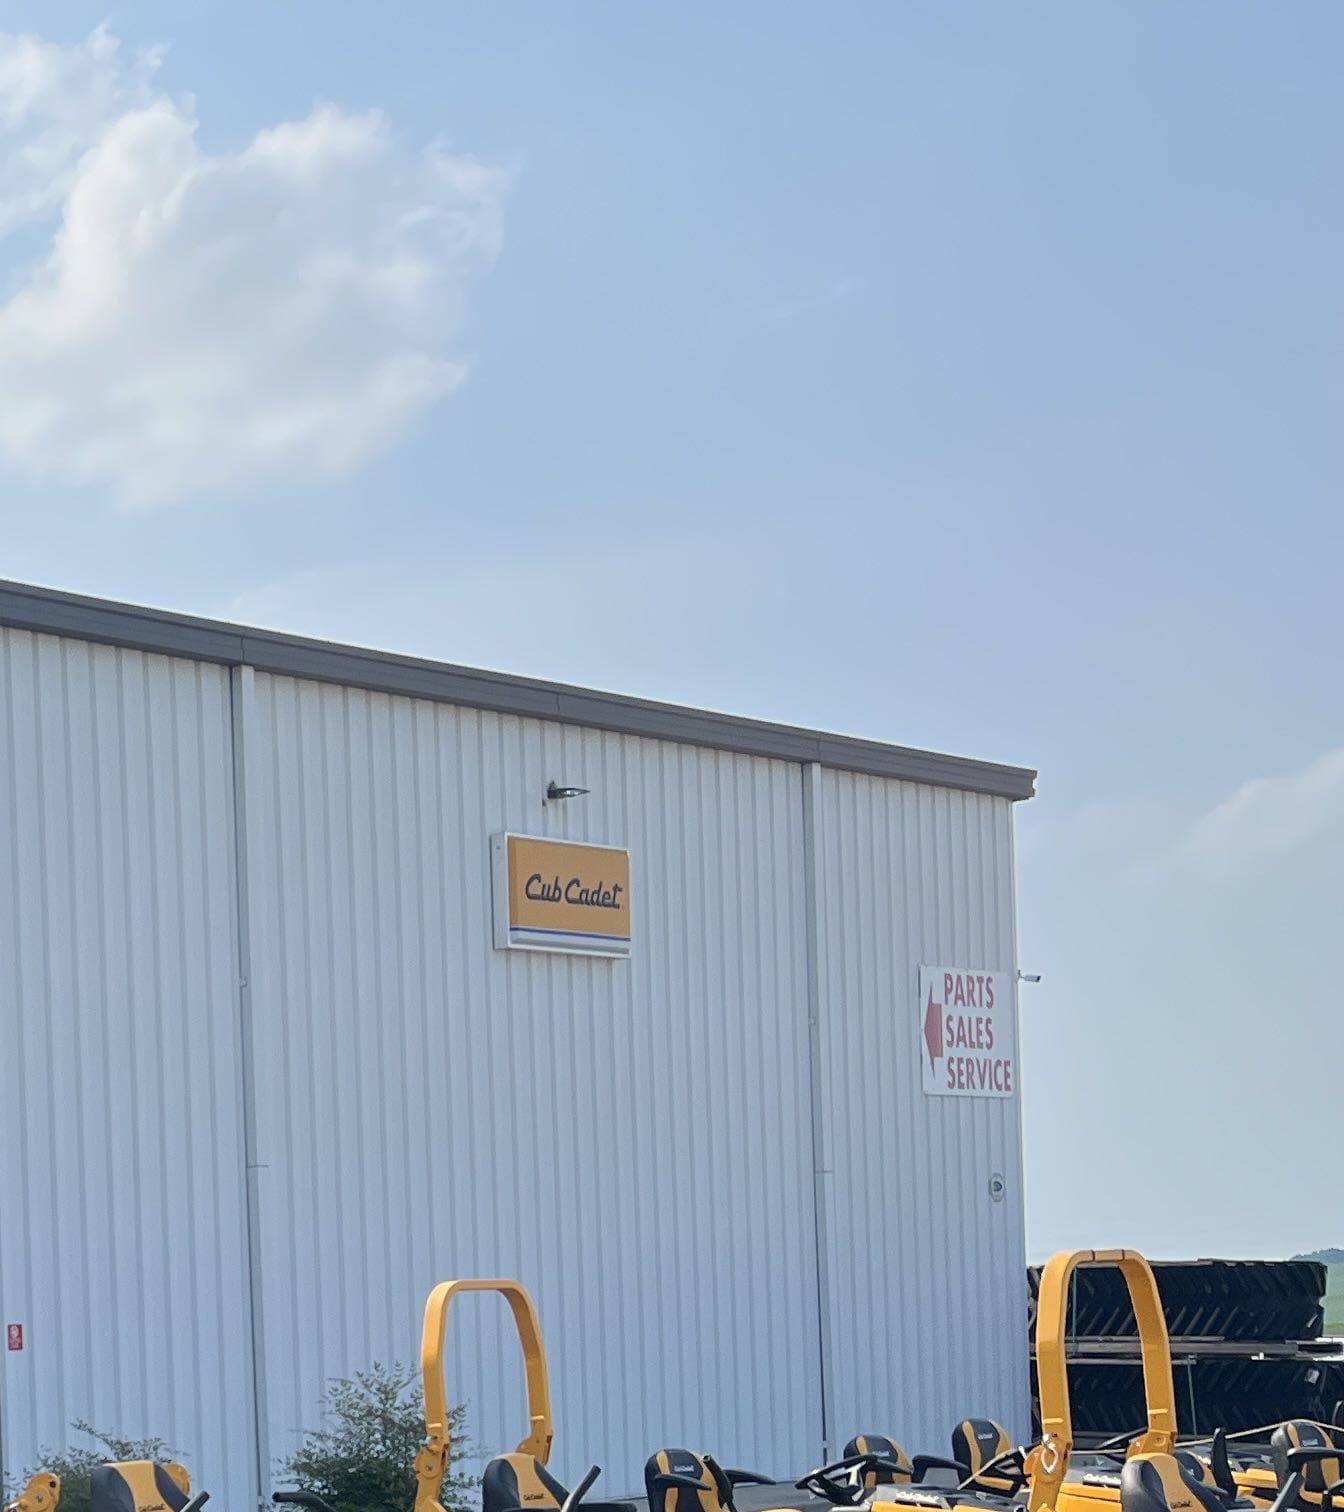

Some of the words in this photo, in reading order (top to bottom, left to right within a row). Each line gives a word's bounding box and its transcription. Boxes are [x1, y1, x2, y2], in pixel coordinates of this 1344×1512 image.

[525, 873, 562, 902] Cub
[565, 878, 623, 909] Cadet
[943, 972, 995, 1009] PARTS
[945, 1014, 995, 1050] SALES
[947, 1056, 1012, 1092] SERVICE
